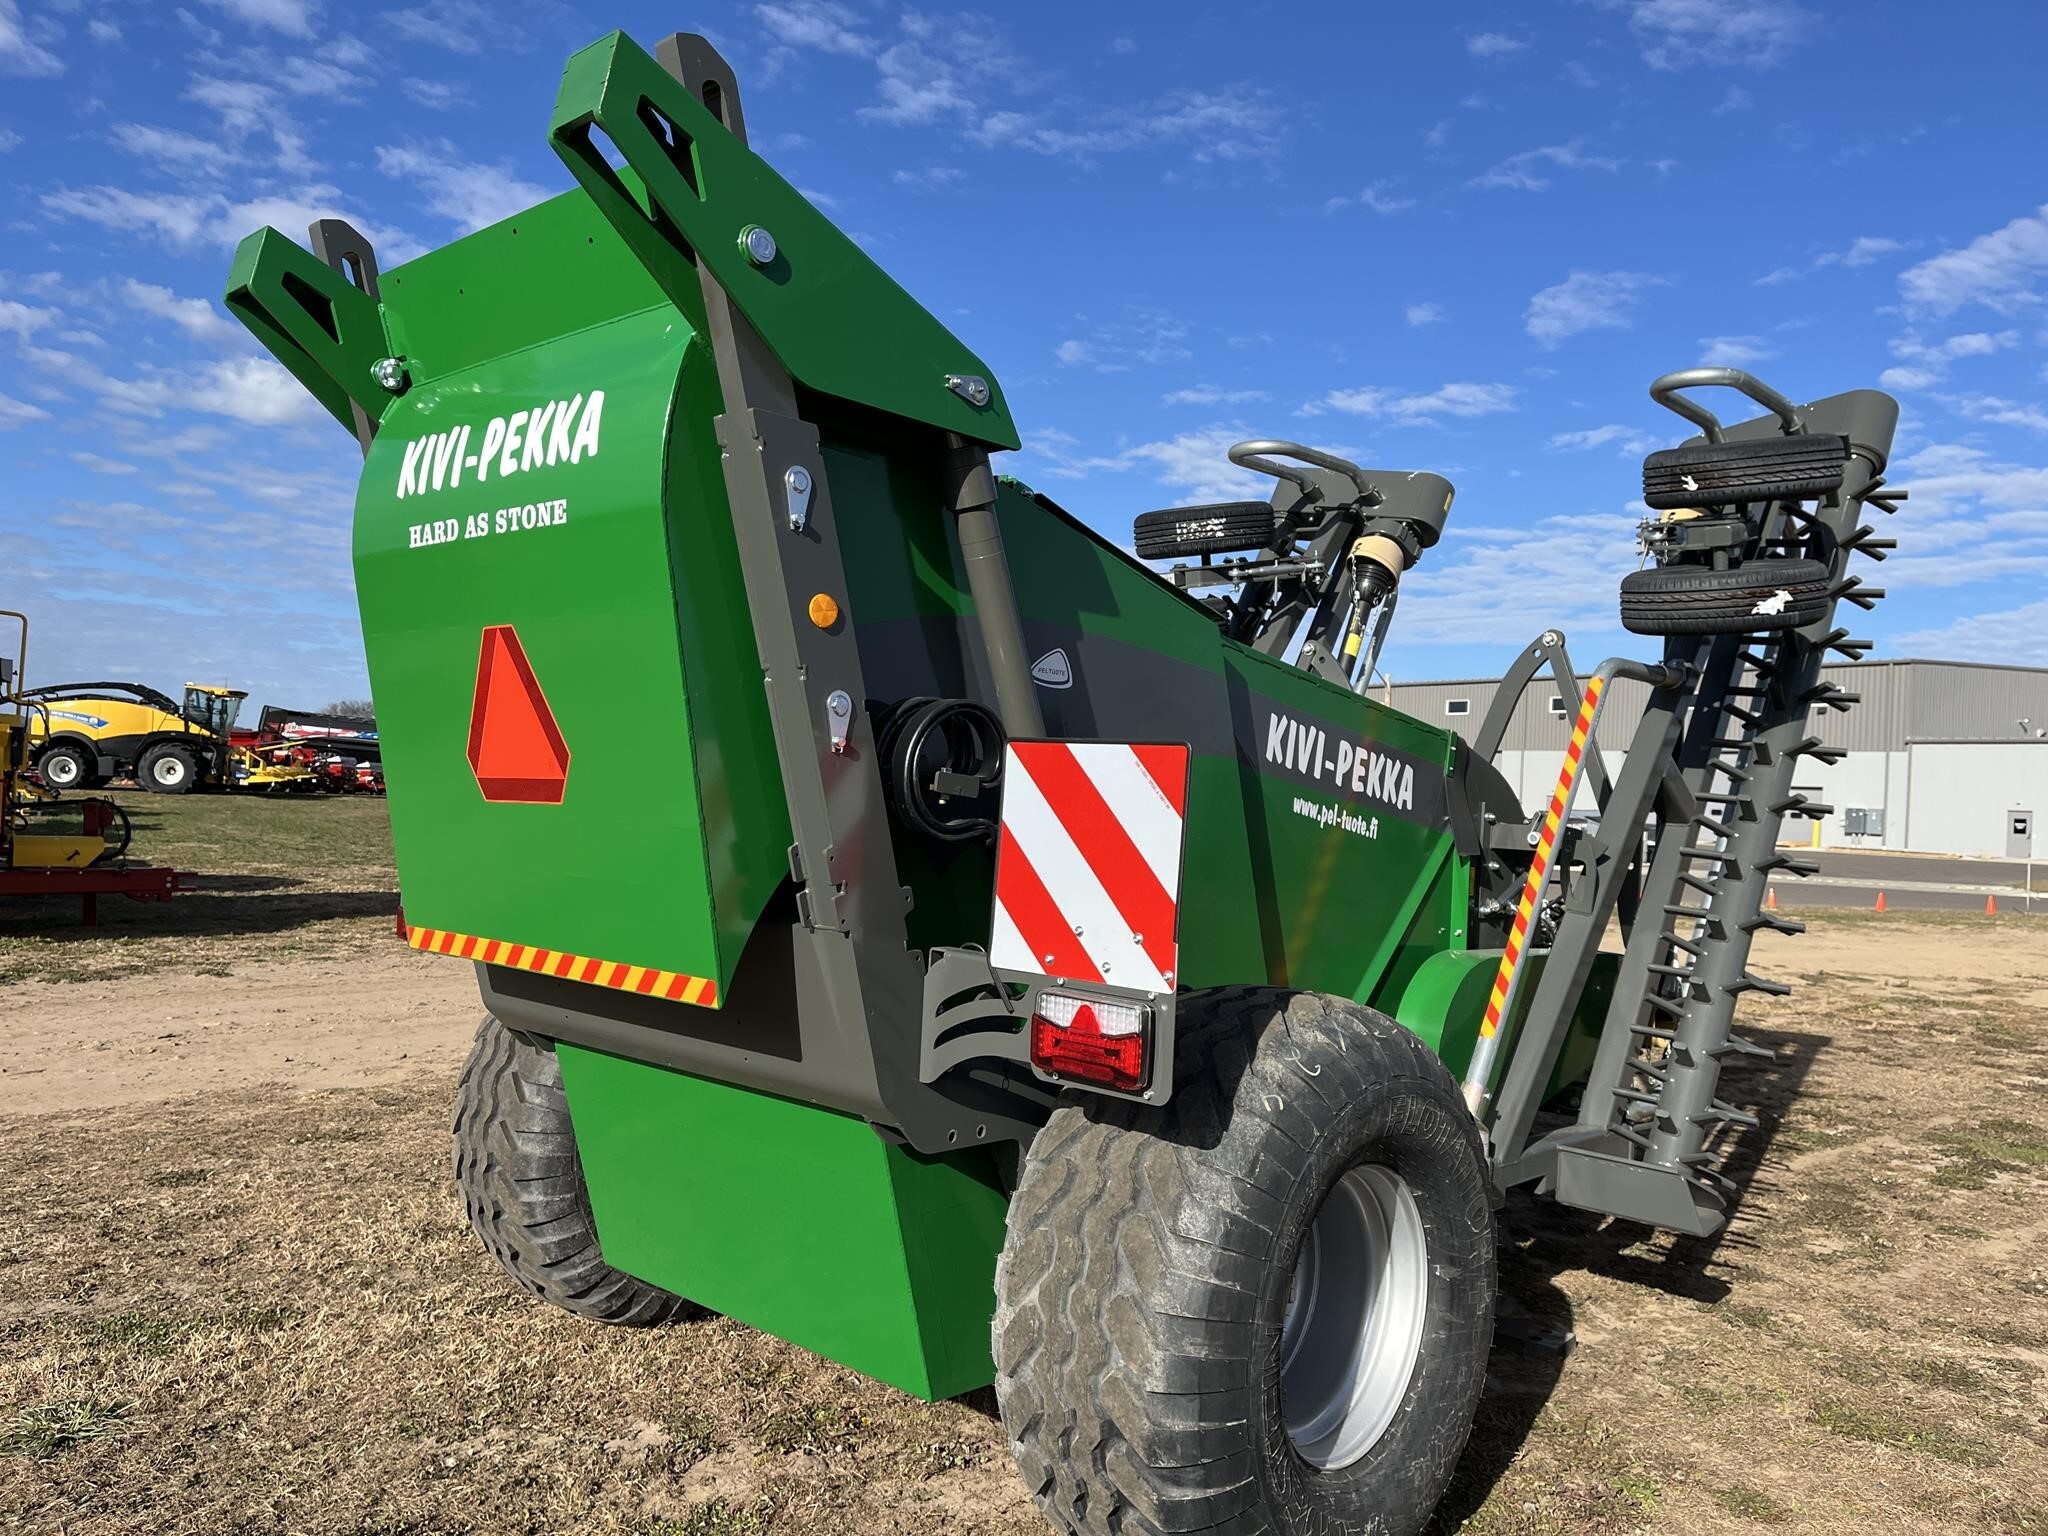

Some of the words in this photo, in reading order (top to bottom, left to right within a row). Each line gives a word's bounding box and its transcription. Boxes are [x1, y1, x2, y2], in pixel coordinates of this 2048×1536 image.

[396, 389, 605, 499] KIVI-PEKKA
[408, 518, 459, 549] HARD
[464, 512, 489, 539] AS
[495, 499, 567, 534] STONE
[1265, 712, 1414, 811] KIVI-PEKKA
[1293, 797, 1379, 840] www.pel-tuote.fi
